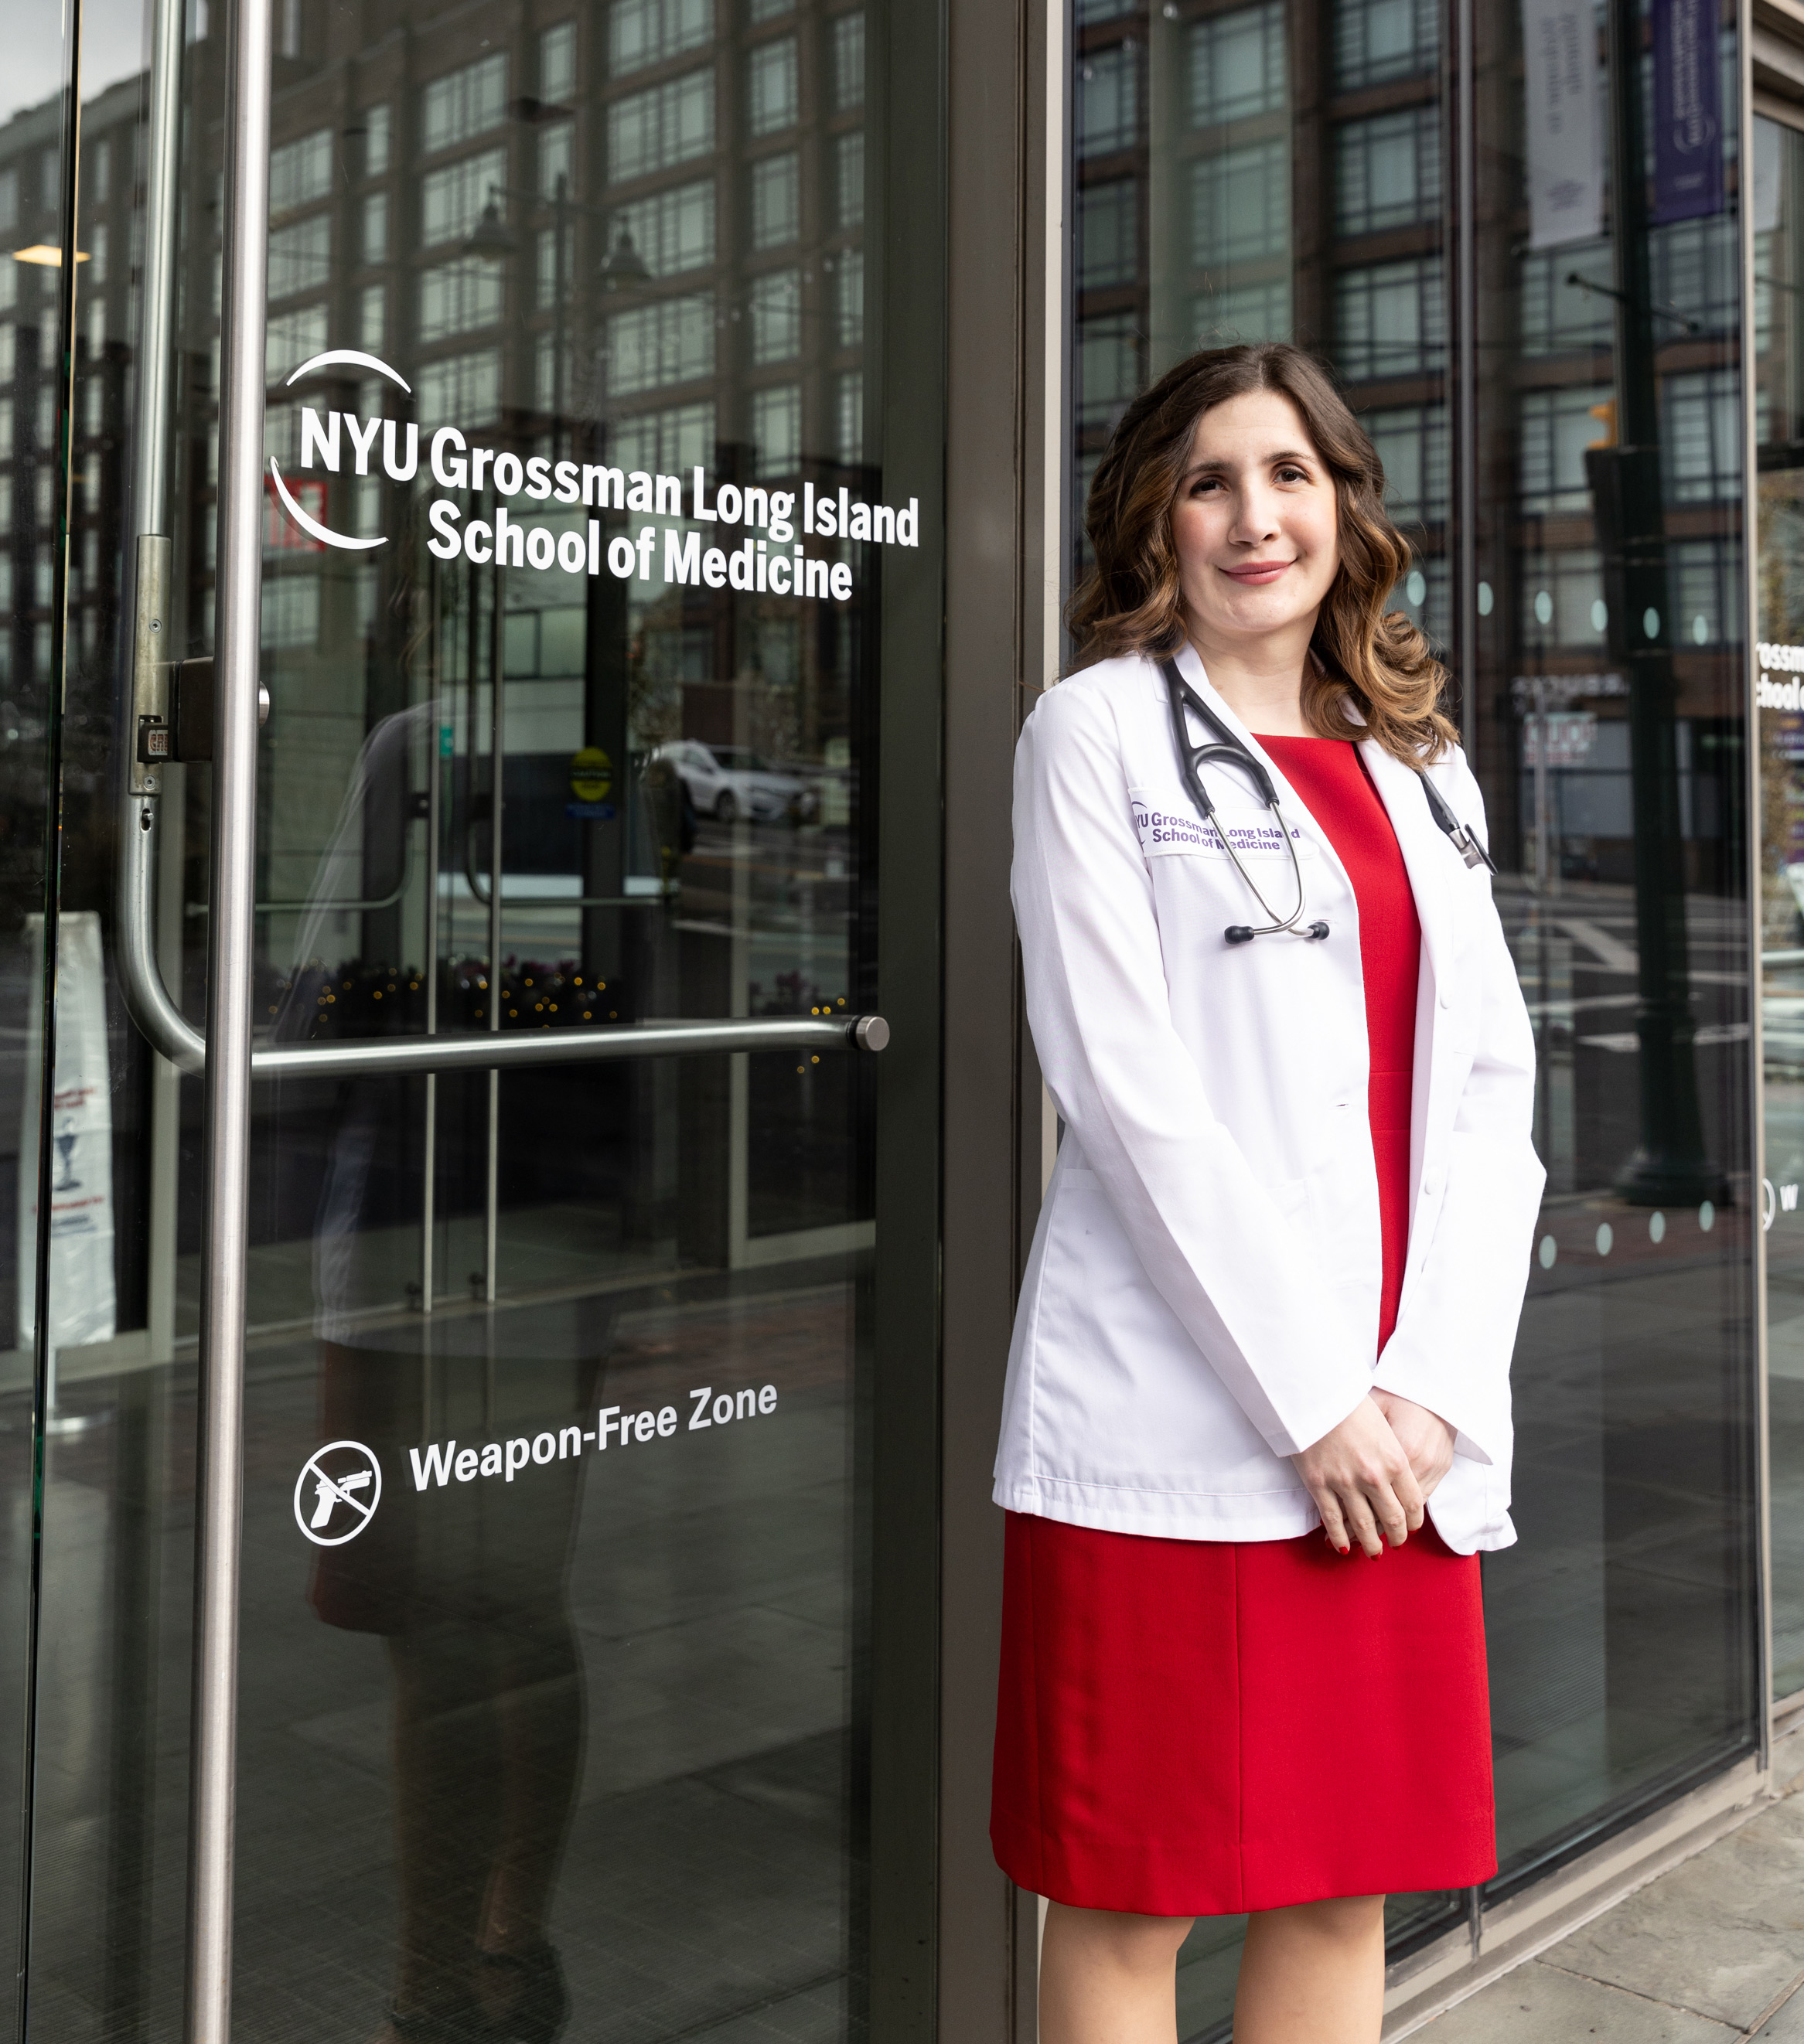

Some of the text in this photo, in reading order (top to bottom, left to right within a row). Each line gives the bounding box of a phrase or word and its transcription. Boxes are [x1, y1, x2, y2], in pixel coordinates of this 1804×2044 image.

[301, 407, 919, 547] NYU Grossman Long Island
[427, 499, 852, 601] School of Medicine
[1151, 812, 1217, 836] Grossman
[1226, 829, 1256, 839] ong
[1257, 827, 1300, 838] Islad
[1152, 828, 1200, 844] School
[1201, 838, 1213, 848] of
[409, 1385, 777, 1492] Weapon-Free Zone
